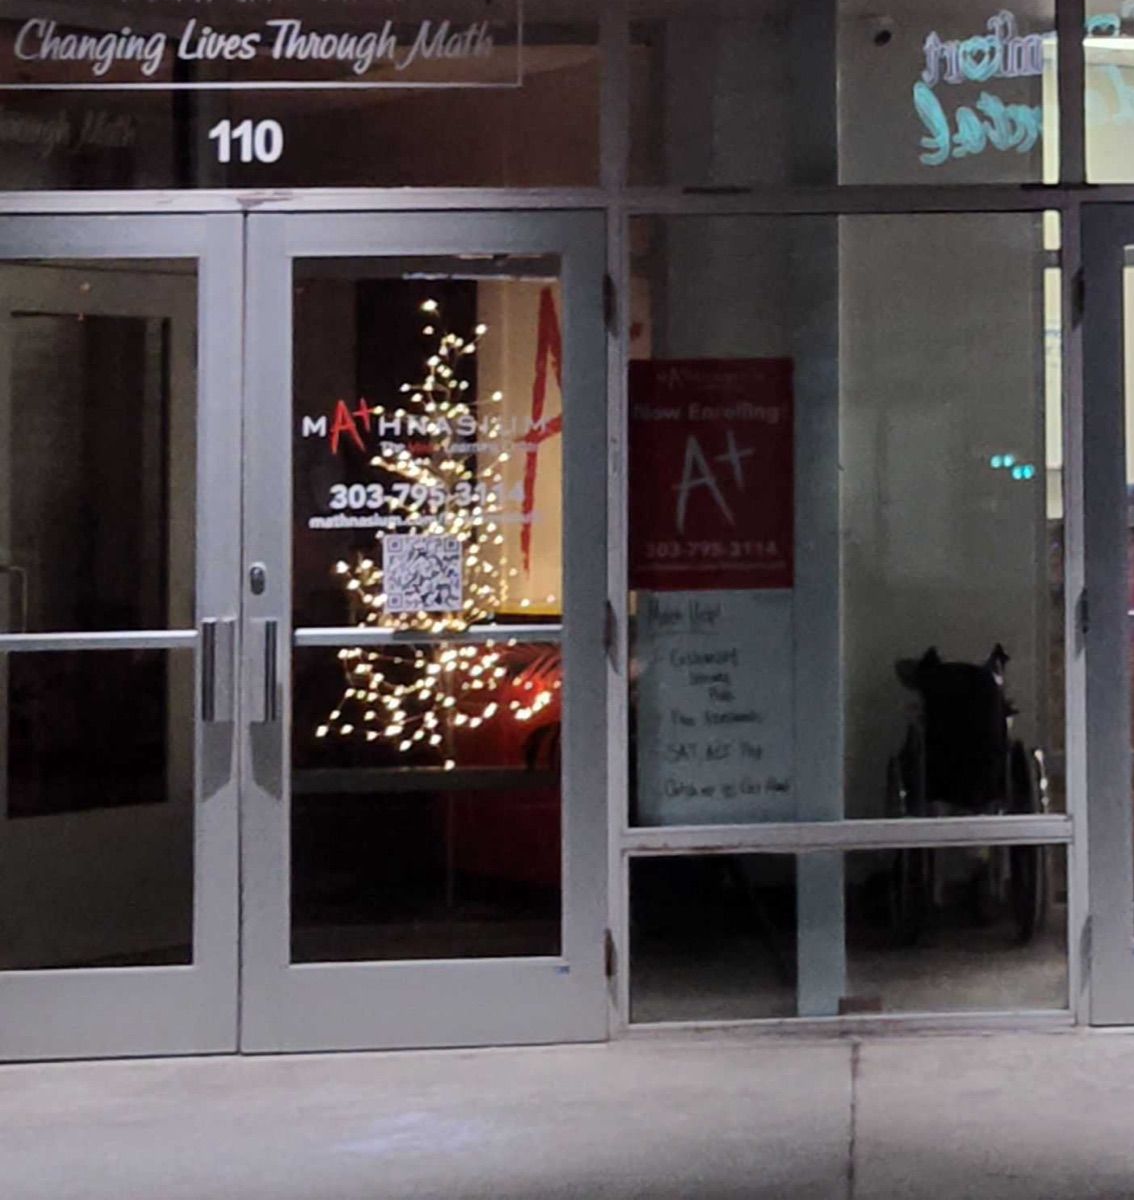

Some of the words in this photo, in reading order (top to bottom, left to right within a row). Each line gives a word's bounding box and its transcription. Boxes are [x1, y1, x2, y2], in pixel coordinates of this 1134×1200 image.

[14, 18, 167, 75] Changing
[177, 18, 261, 62] Lives
[266, 18, 397, 75] Through
[395, 19, 494, 71] Math
[208, 119, 284, 164] 110
